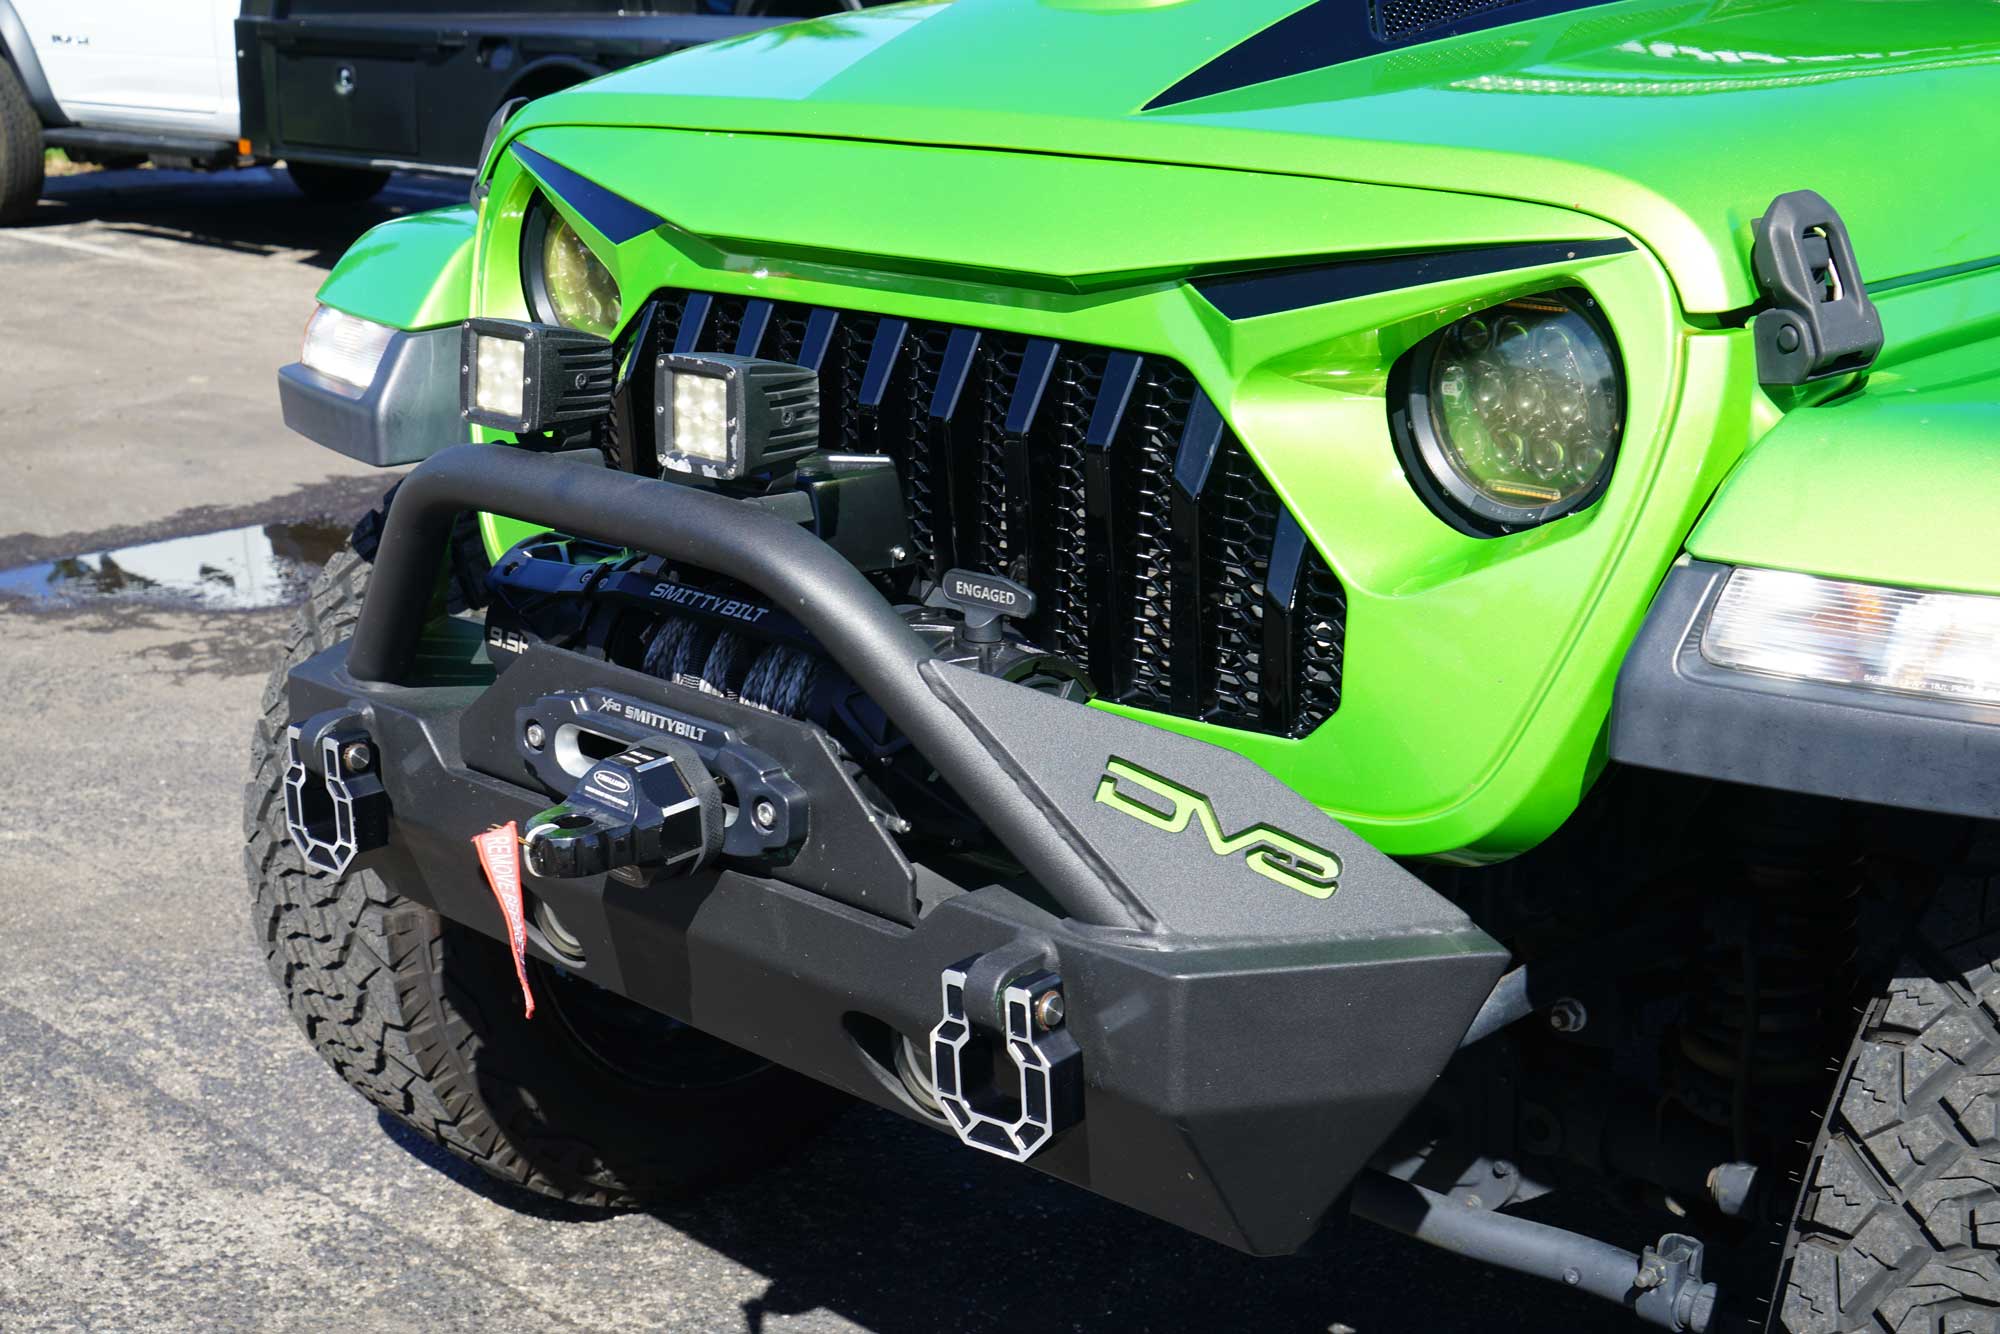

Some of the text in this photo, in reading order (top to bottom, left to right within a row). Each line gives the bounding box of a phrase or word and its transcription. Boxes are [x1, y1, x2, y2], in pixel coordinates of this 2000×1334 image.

[649, 582, 769, 622] SMITTYBILT
[956, 581, 1016, 605] ENGAGED
[624, 705, 707, 741] SMITTYBILT
[1095, 754, 1342, 900] DV8
[486, 835, 516, 893] REMOVE
